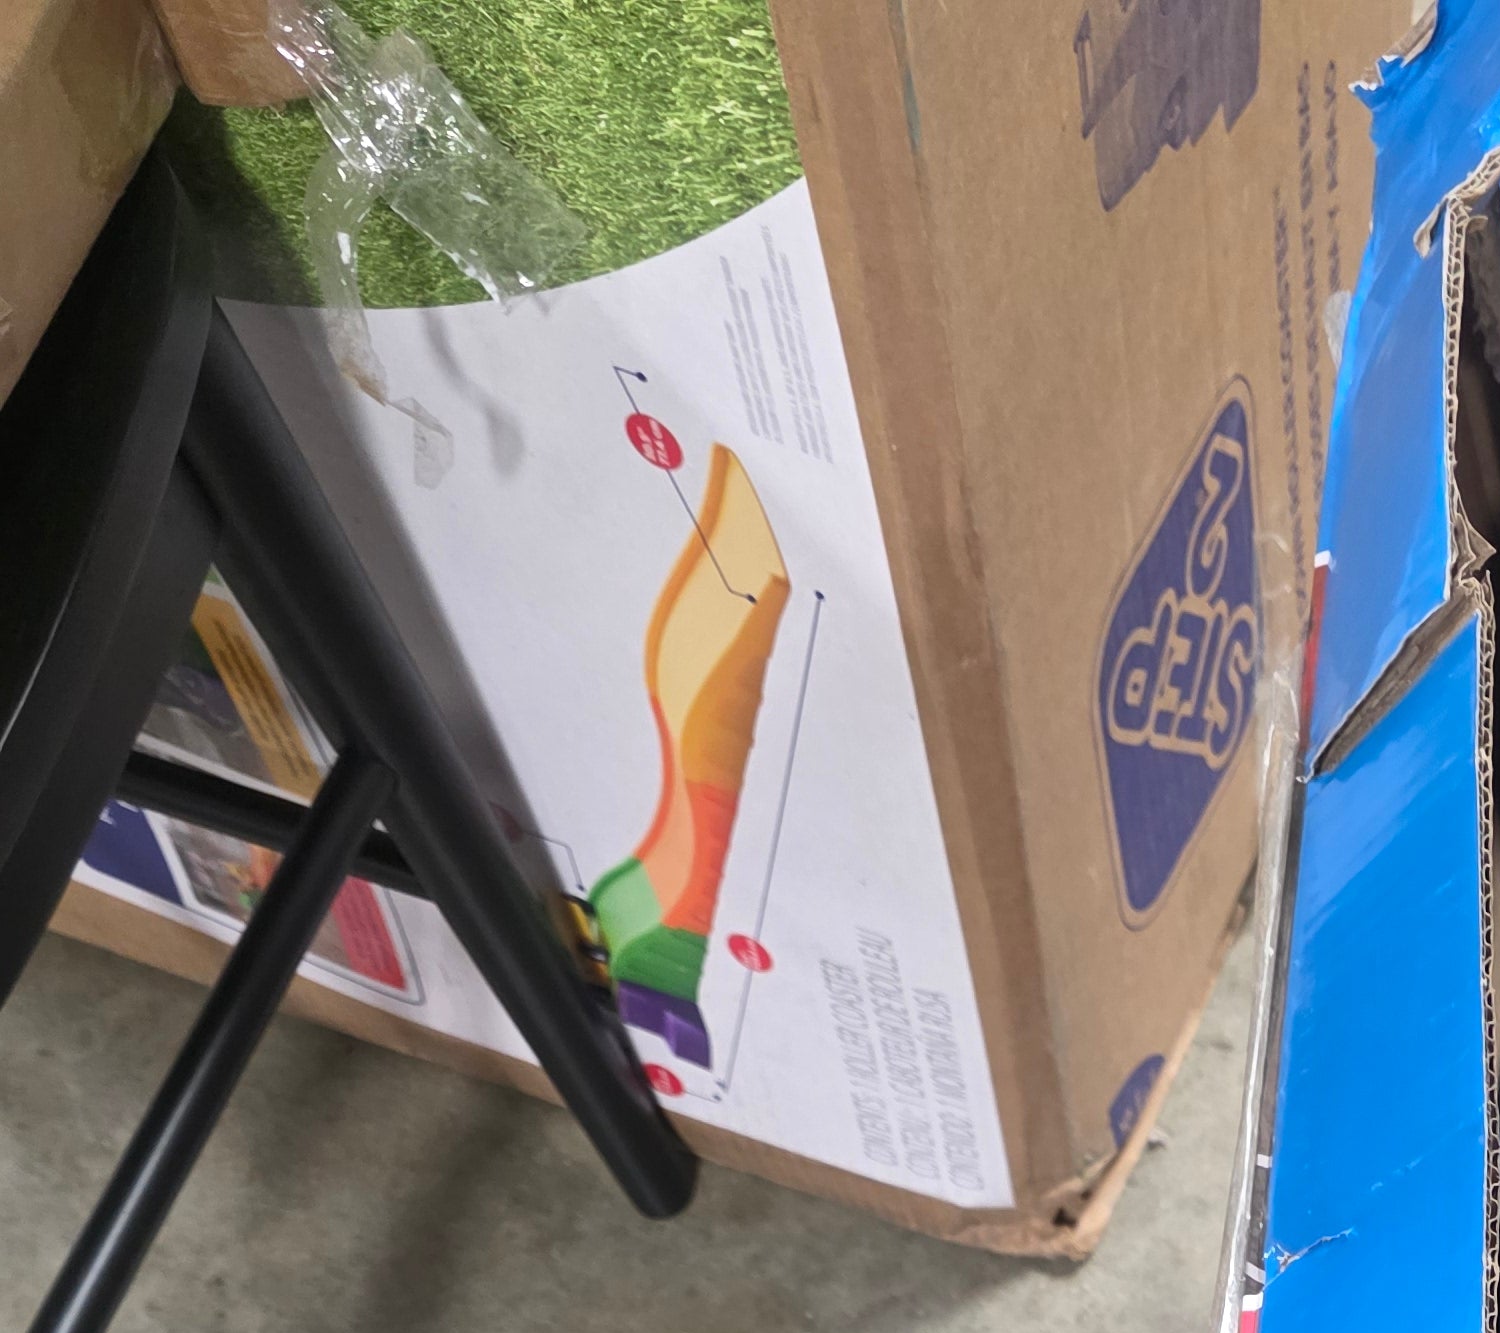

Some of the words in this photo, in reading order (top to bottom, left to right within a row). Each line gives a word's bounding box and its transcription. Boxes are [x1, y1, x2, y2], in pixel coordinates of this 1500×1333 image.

[1184, 431, 1245, 603] 2
[1106, 587, 1256, 770] STEP
[818, 959, 868, 1028] COASTER
[856, 926, 904, 1003] ROULEAU
[870, 998, 910, 1026] DE
[910, 988, 954, 1028] RUSA
[833, 1026, 879, 1083] ROLLER
[874, 1021, 925, 1099] CABOTEUR
